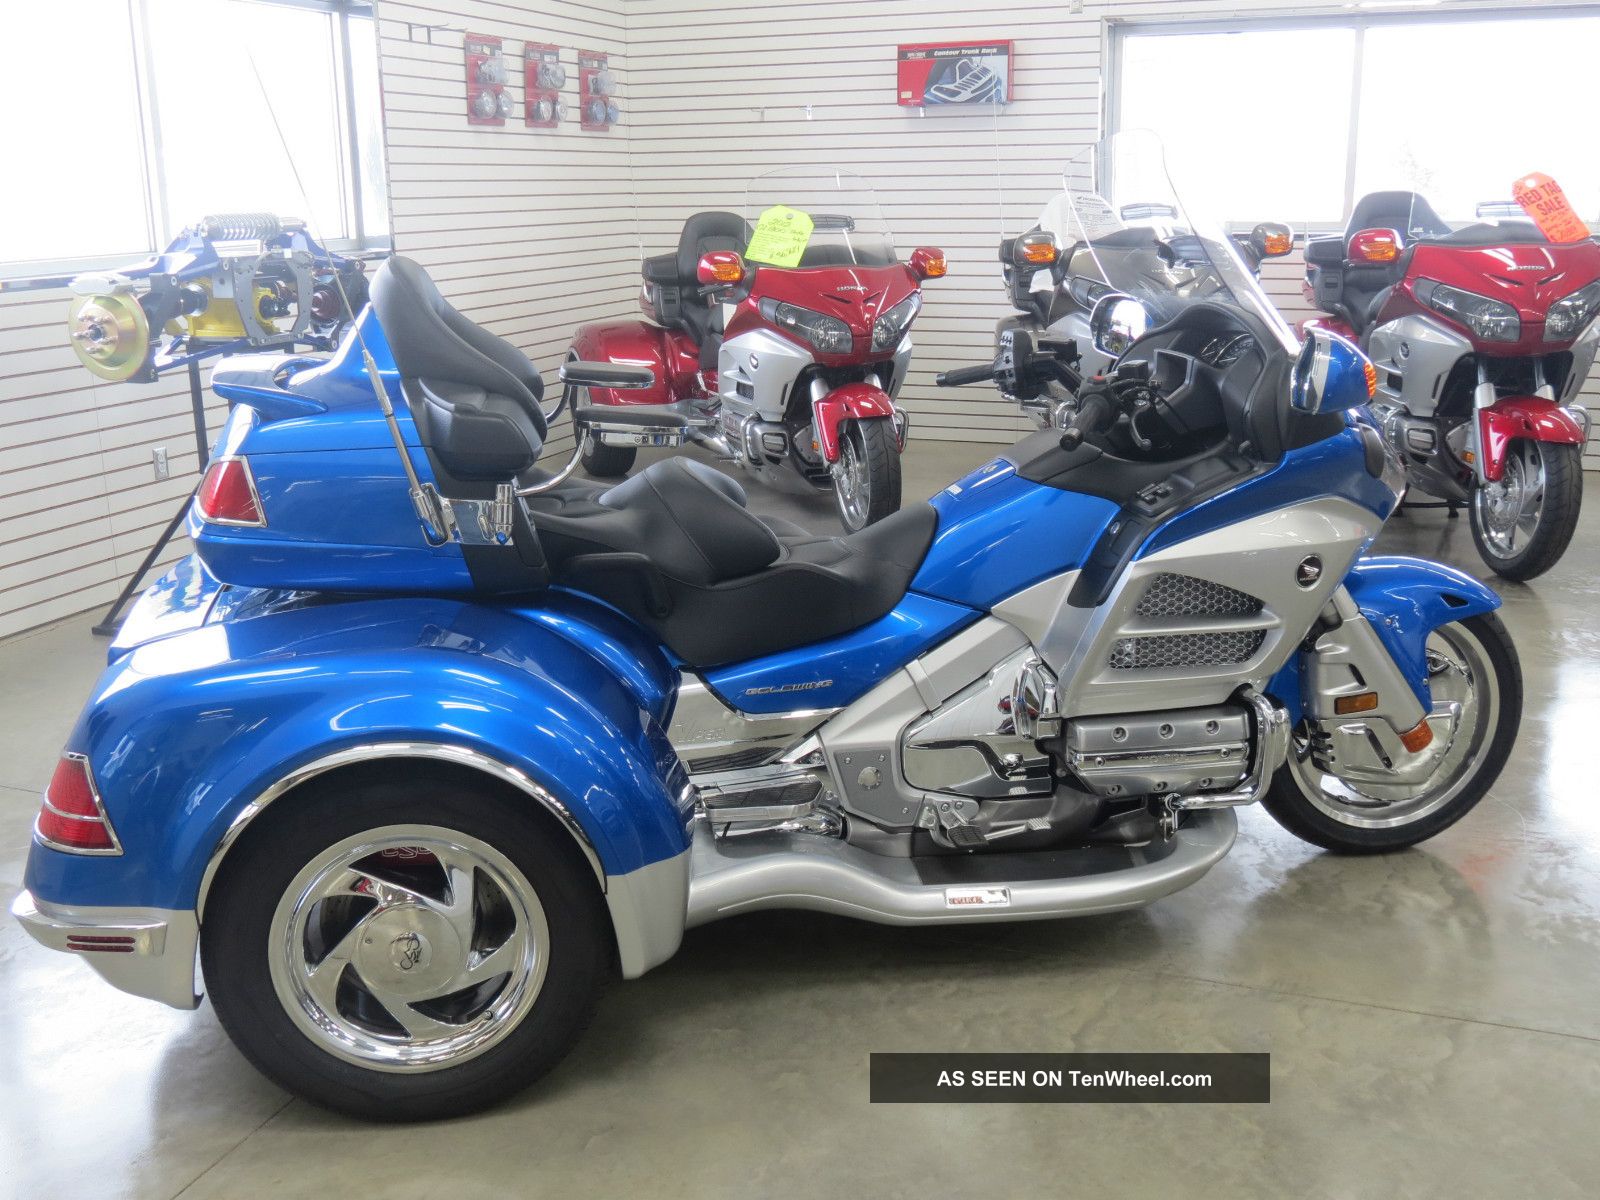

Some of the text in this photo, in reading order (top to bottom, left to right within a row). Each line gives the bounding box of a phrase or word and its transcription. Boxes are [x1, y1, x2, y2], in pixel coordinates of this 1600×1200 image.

[1516, 190, 1543, 208] RED
[1540, 180, 1562, 197] TAG
[1537, 195, 1565, 216] SALE
